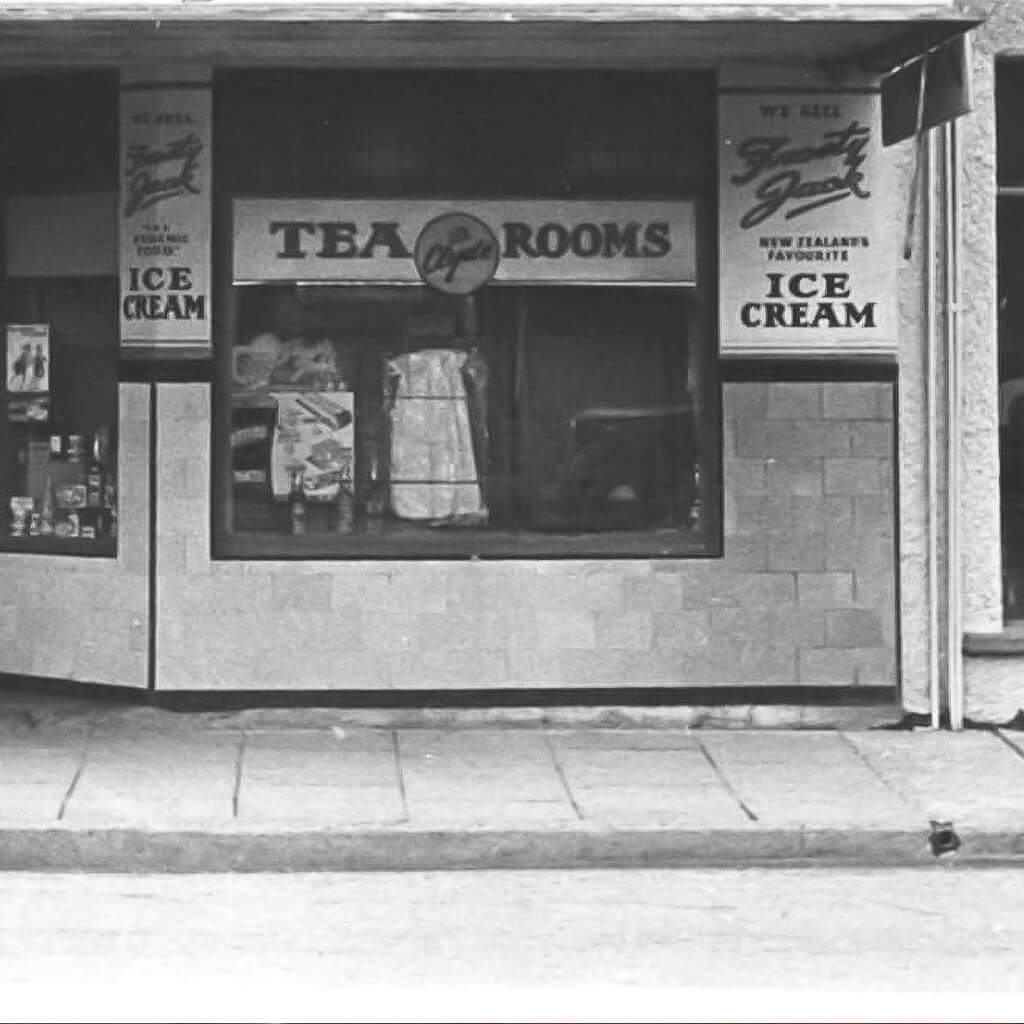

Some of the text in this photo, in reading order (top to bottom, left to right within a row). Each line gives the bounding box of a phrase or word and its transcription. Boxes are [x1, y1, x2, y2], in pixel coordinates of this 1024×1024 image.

[740, 166, 871, 229] Jack
[269, 221, 413, 260] TEA
[502, 221, 672, 259] ROOMS
[759, 236, 793, 248] NEW
[767, 250, 849, 262] FAVOURITE
[128, 266, 193, 292] ICE
[765, 273, 850, 299] ICE
[122, 294, 206, 321] CREAM
[740, 302, 878, 328] CREAM
